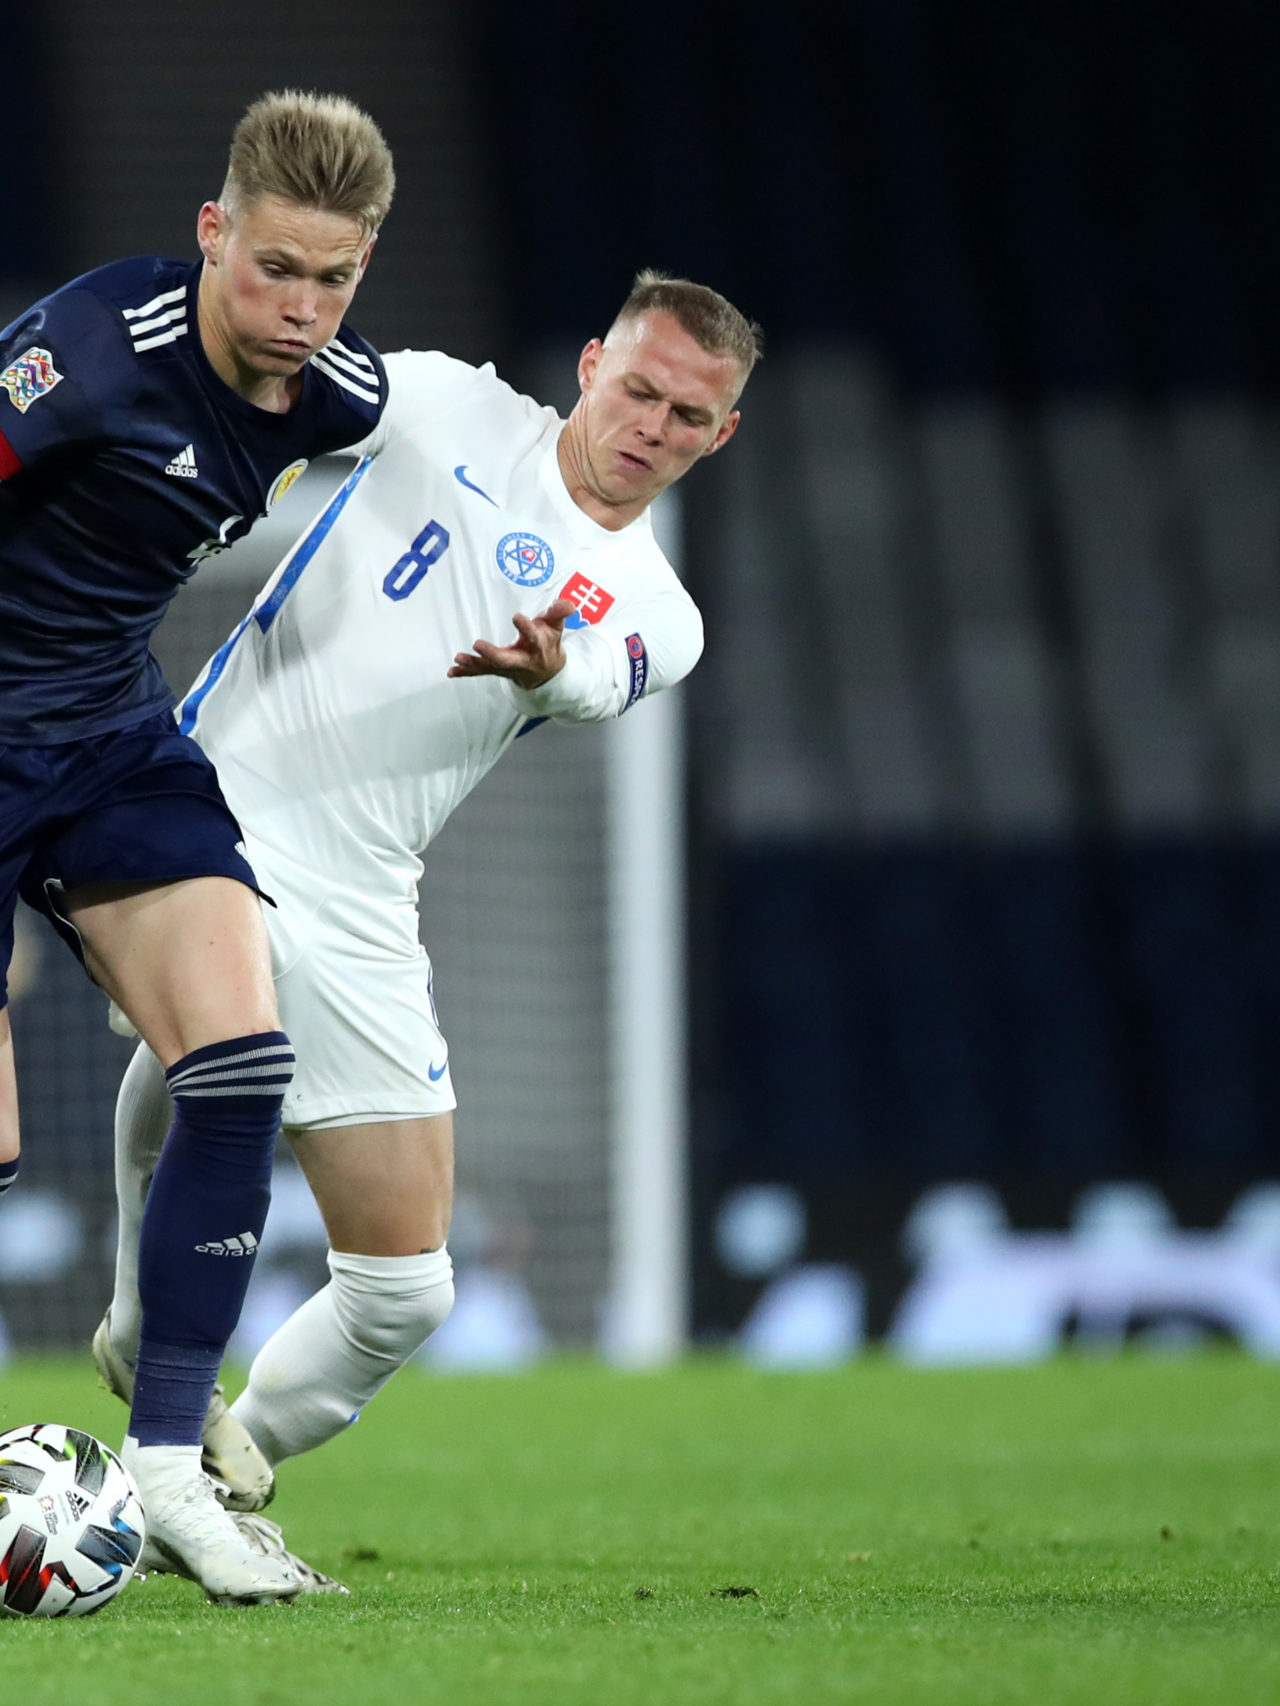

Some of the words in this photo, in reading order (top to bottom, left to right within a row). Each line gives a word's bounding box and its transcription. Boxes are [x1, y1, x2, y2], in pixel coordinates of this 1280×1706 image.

[165, 464, 199, 479] adidas
[383, 519, 450, 602] 8
[194, 1244, 256, 1257] adida
